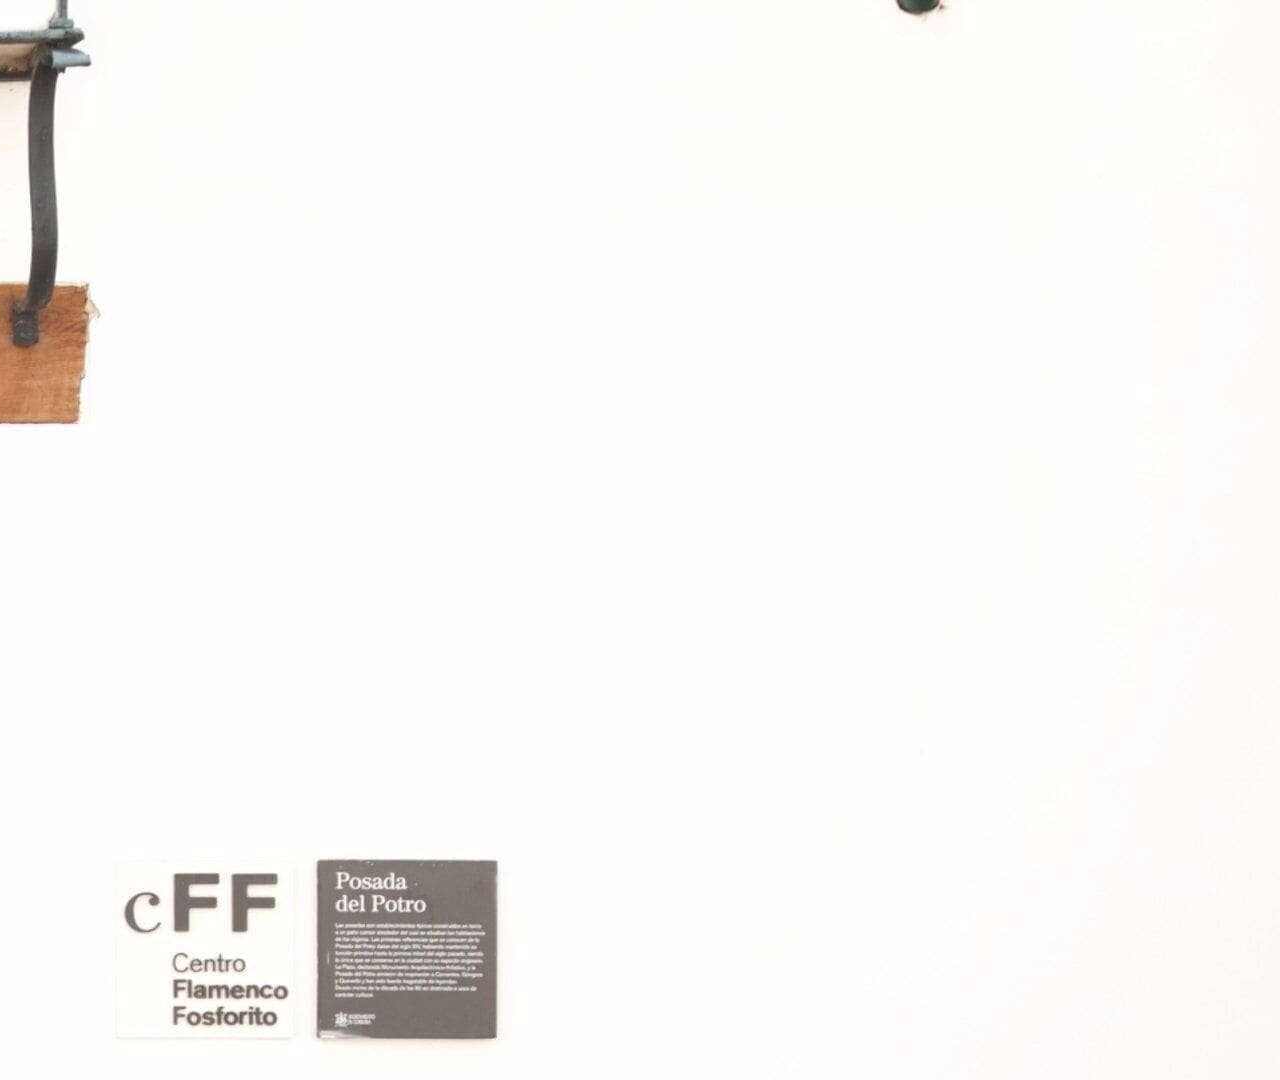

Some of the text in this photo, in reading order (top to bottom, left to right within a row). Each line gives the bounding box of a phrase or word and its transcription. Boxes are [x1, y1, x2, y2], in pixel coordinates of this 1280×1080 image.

[335, 871, 407, 890] Posada
[124, 873, 278, 933] cFF
[335, 894, 427, 913] del Potro
[172, 952, 246, 973] Centro
[173, 979, 288, 1000] Flamenco
[173, 1006, 278, 1026] Fosforito
